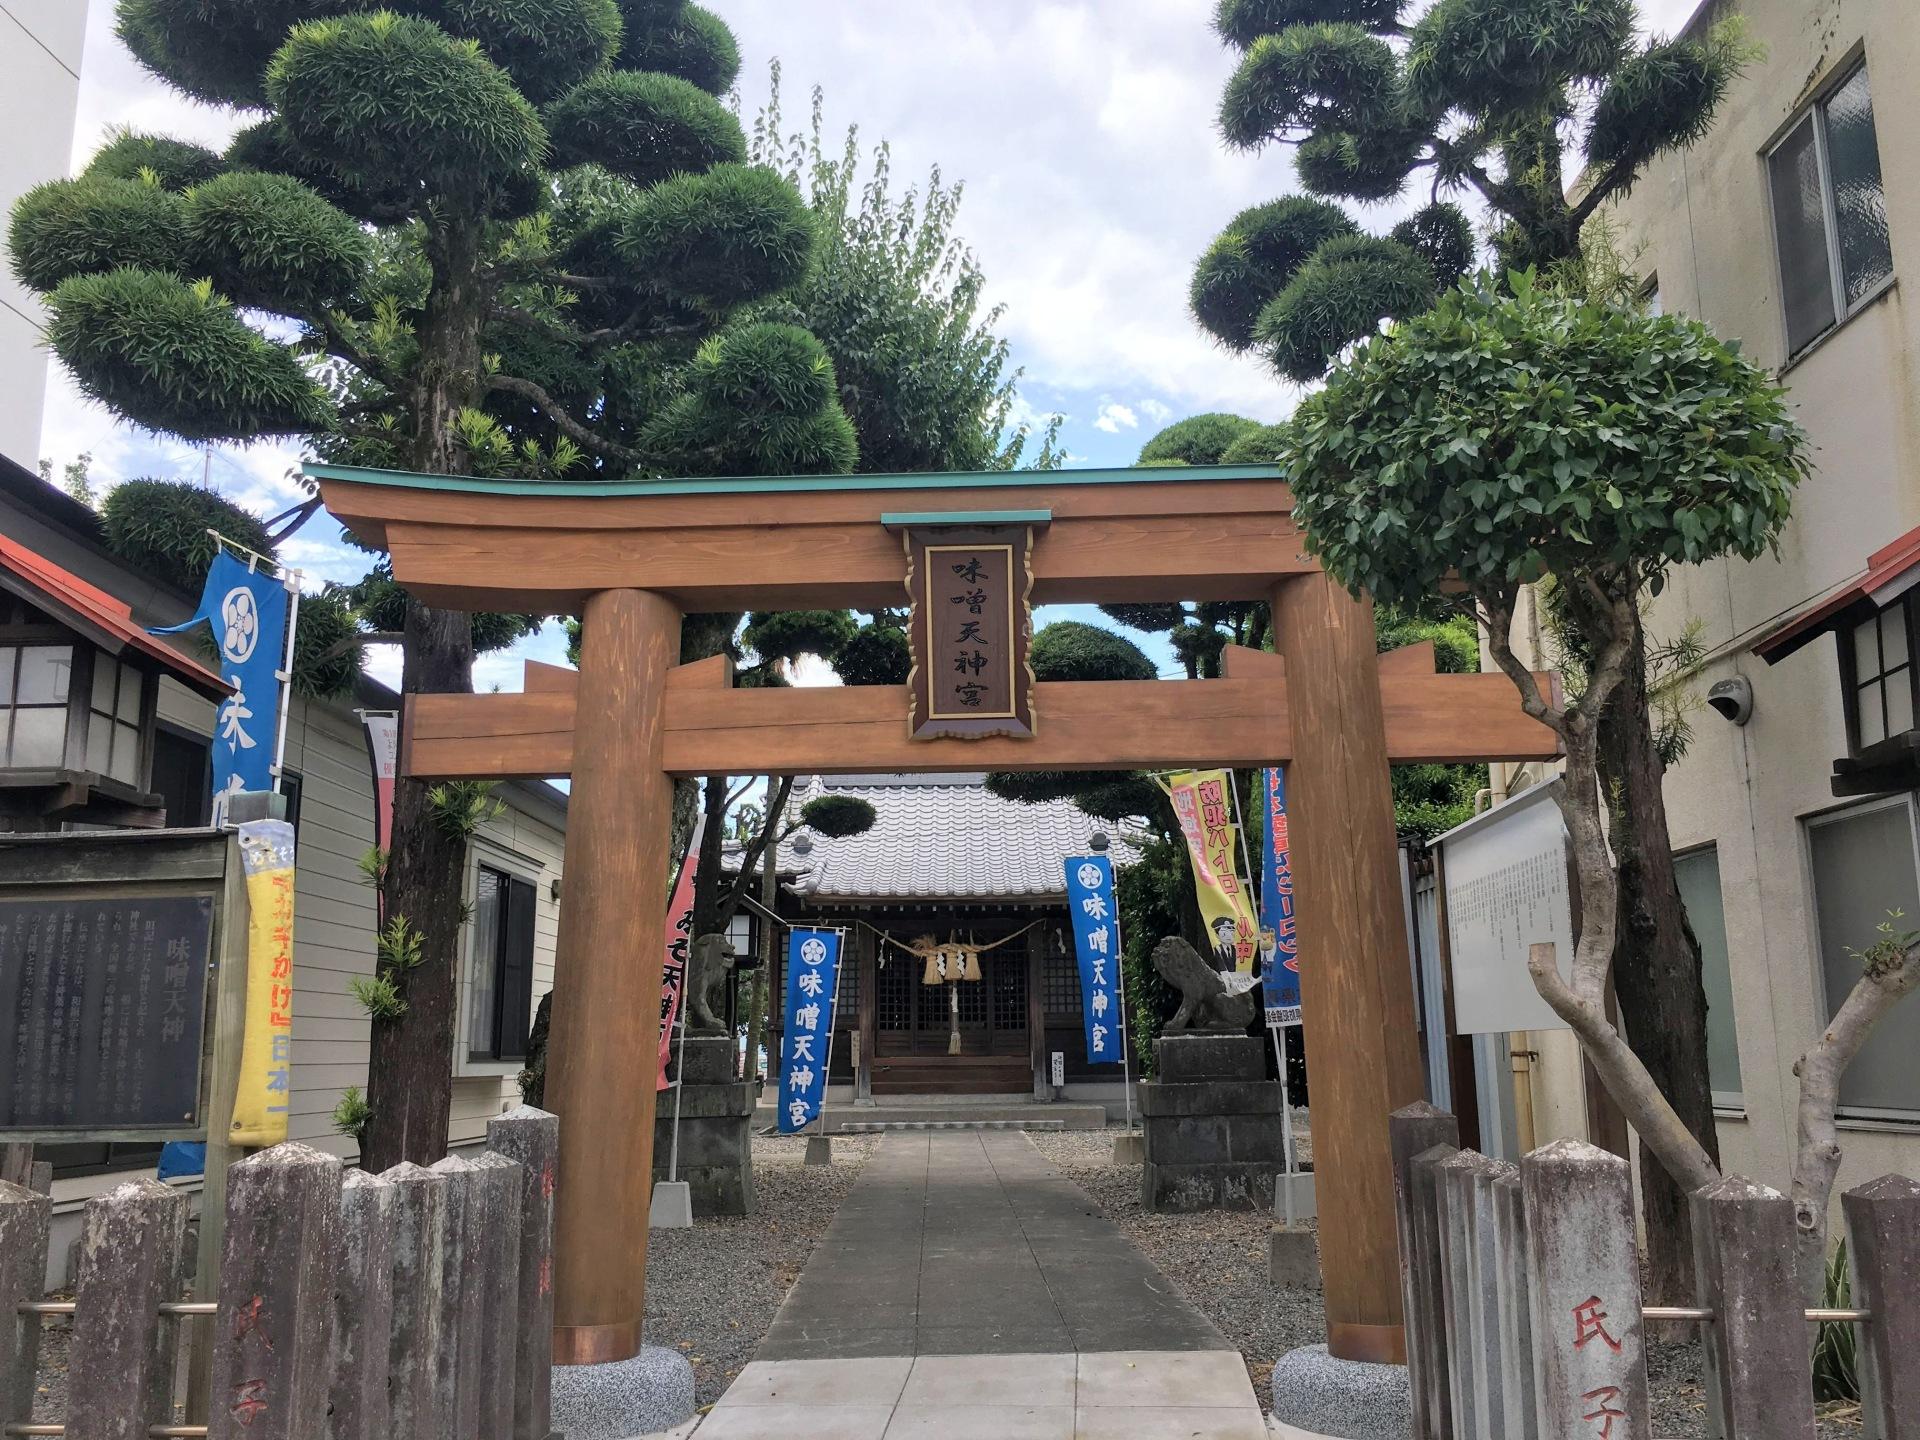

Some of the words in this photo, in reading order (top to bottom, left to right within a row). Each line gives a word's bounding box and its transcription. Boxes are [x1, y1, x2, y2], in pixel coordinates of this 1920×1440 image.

[950, 557, 989, 707] 味噌天神宮
[788, 968, 824, 1127] 味噌天神宮
[1081, 891, 1109, 1053] 味噌天神宮
[1571, 1295, 1626, 1440] 氏子
